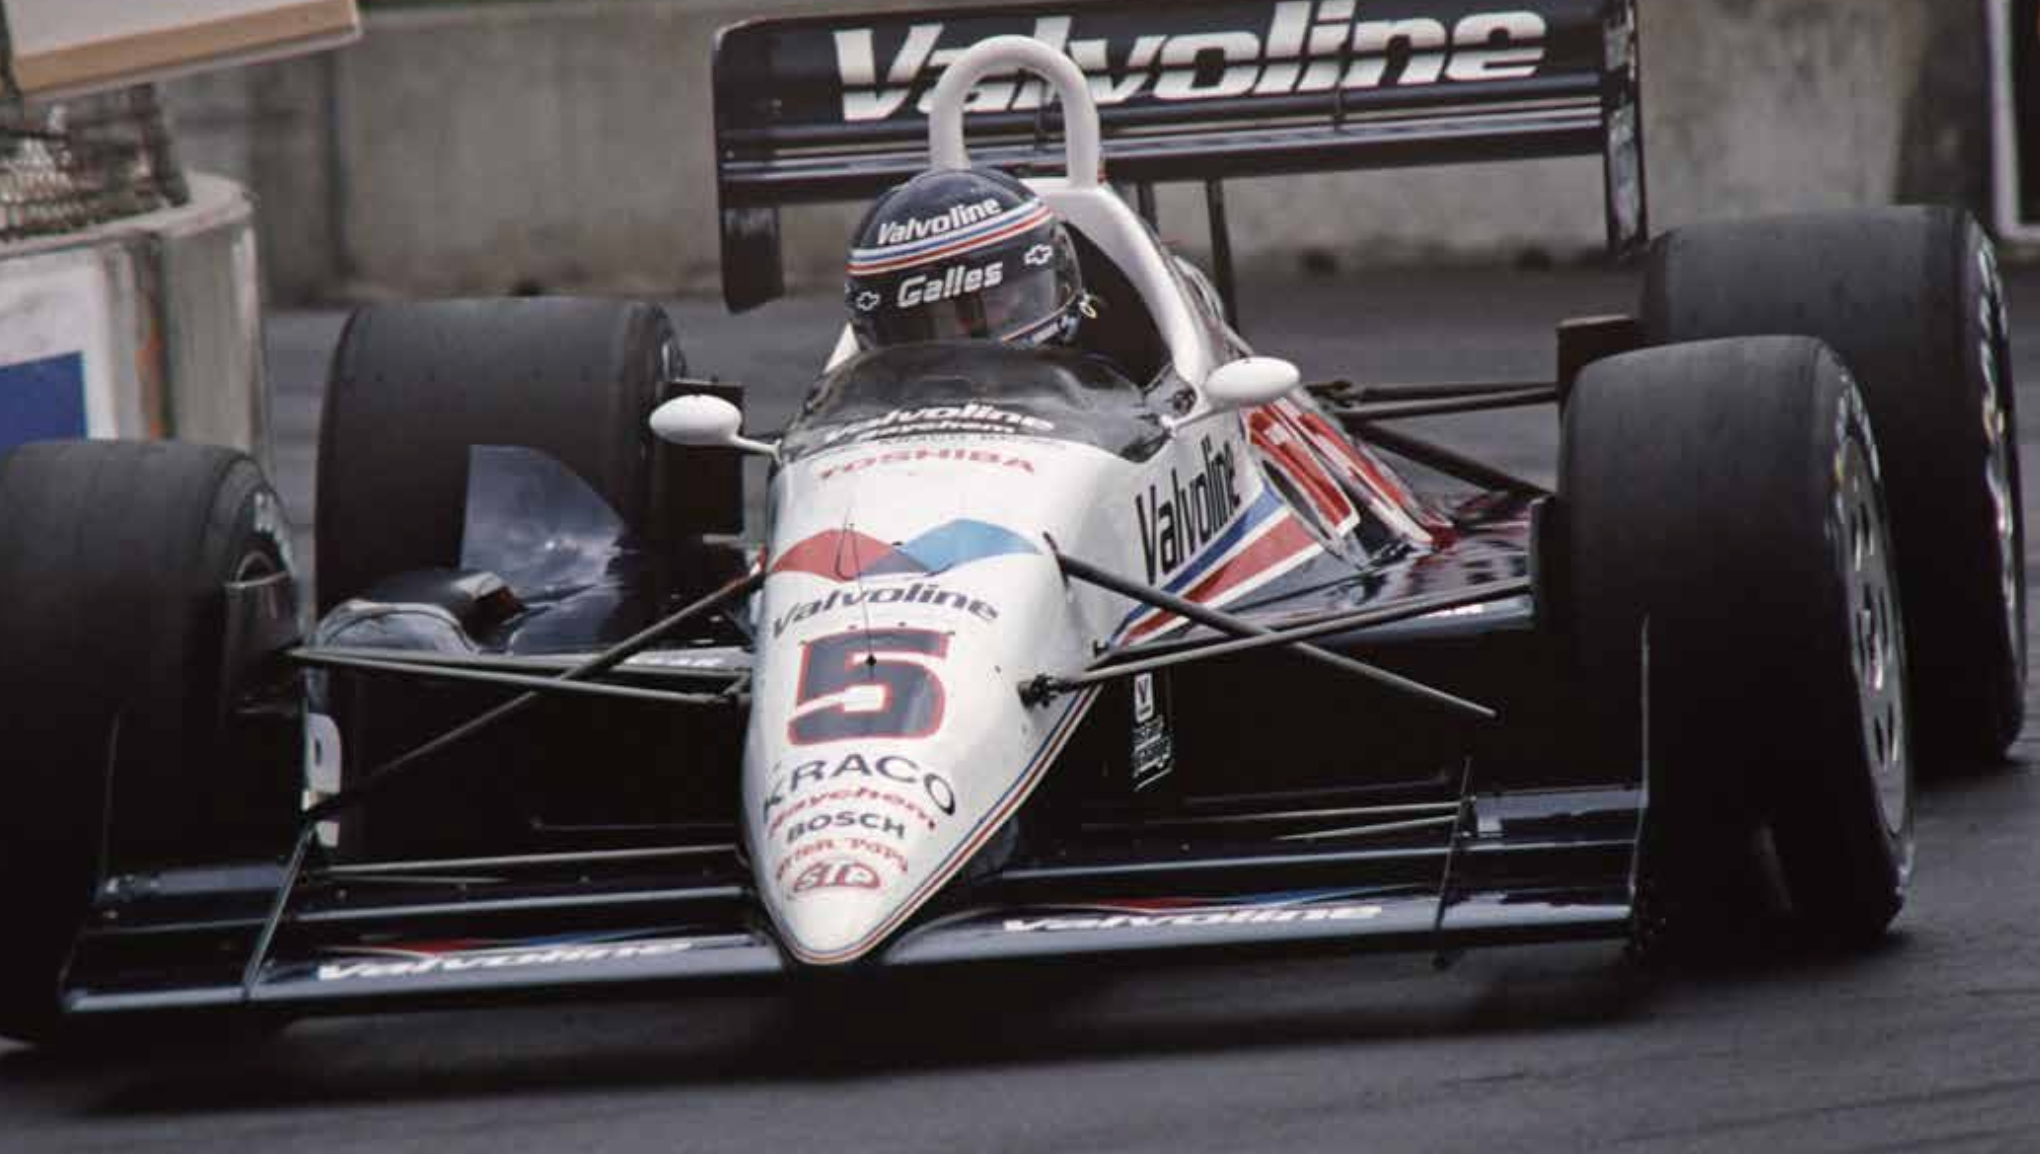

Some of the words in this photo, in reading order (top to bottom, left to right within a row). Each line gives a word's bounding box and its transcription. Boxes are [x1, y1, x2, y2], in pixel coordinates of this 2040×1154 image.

[877, 198, 1001, 245] Valvoline
[897, 261, 1003, 308] Galles
[1135, 434, 1241, 587] Valvoline
[773, 582, 998, 638] Valvoline
[787, 627, 950, 746] 5
[763, 754, 956, 824] KRACO
[787, 810, 905, 844] BOSCH
